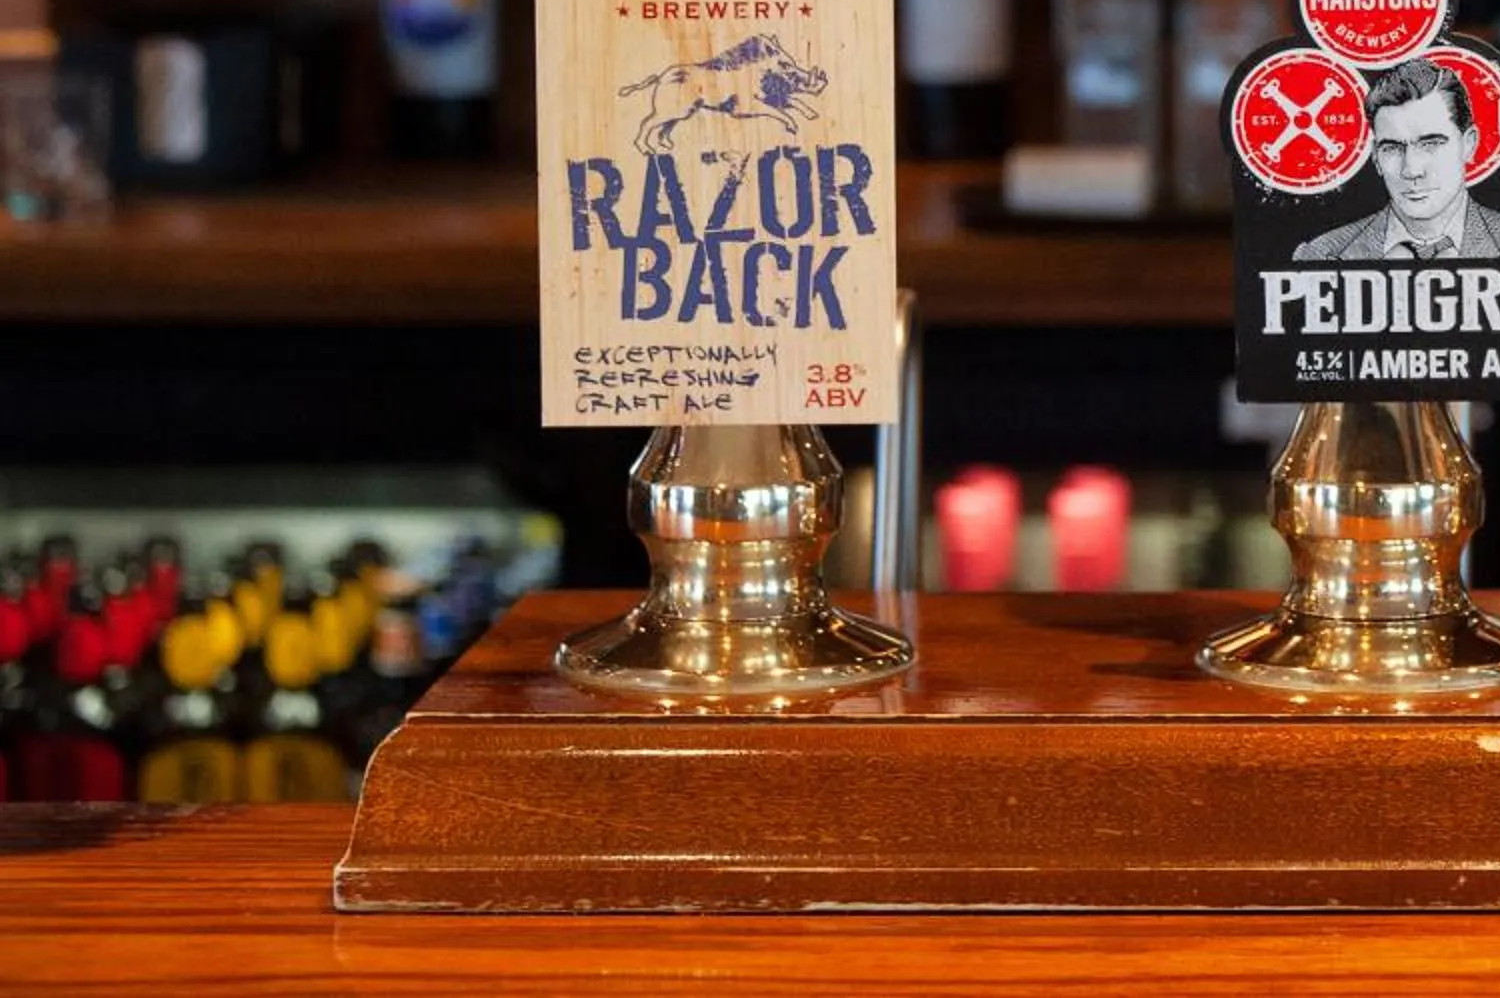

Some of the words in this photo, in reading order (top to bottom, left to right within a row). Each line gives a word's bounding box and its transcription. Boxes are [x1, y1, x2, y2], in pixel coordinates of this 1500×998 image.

[641, 2, 789, 20] BREWERY
[1334, 22, 1408, 48] BREWERY
[1252, 114, 1279, 126] EST.
[1323, 113, 1355, 125] 1834
[566, 143, 877, 251] RAZOR
[620, 235, 848, 331] BACK
[574, 341, 778, 366] EXCEPTIONALLY
[1359, 349, 1469, 379] AMBER
[574, 368, 760, 388] REFRESHING
[574, 392, 669, 415] CRAFT
[684, 393, 734, 414] ALE
[804, 388, 866, 408] ABV
